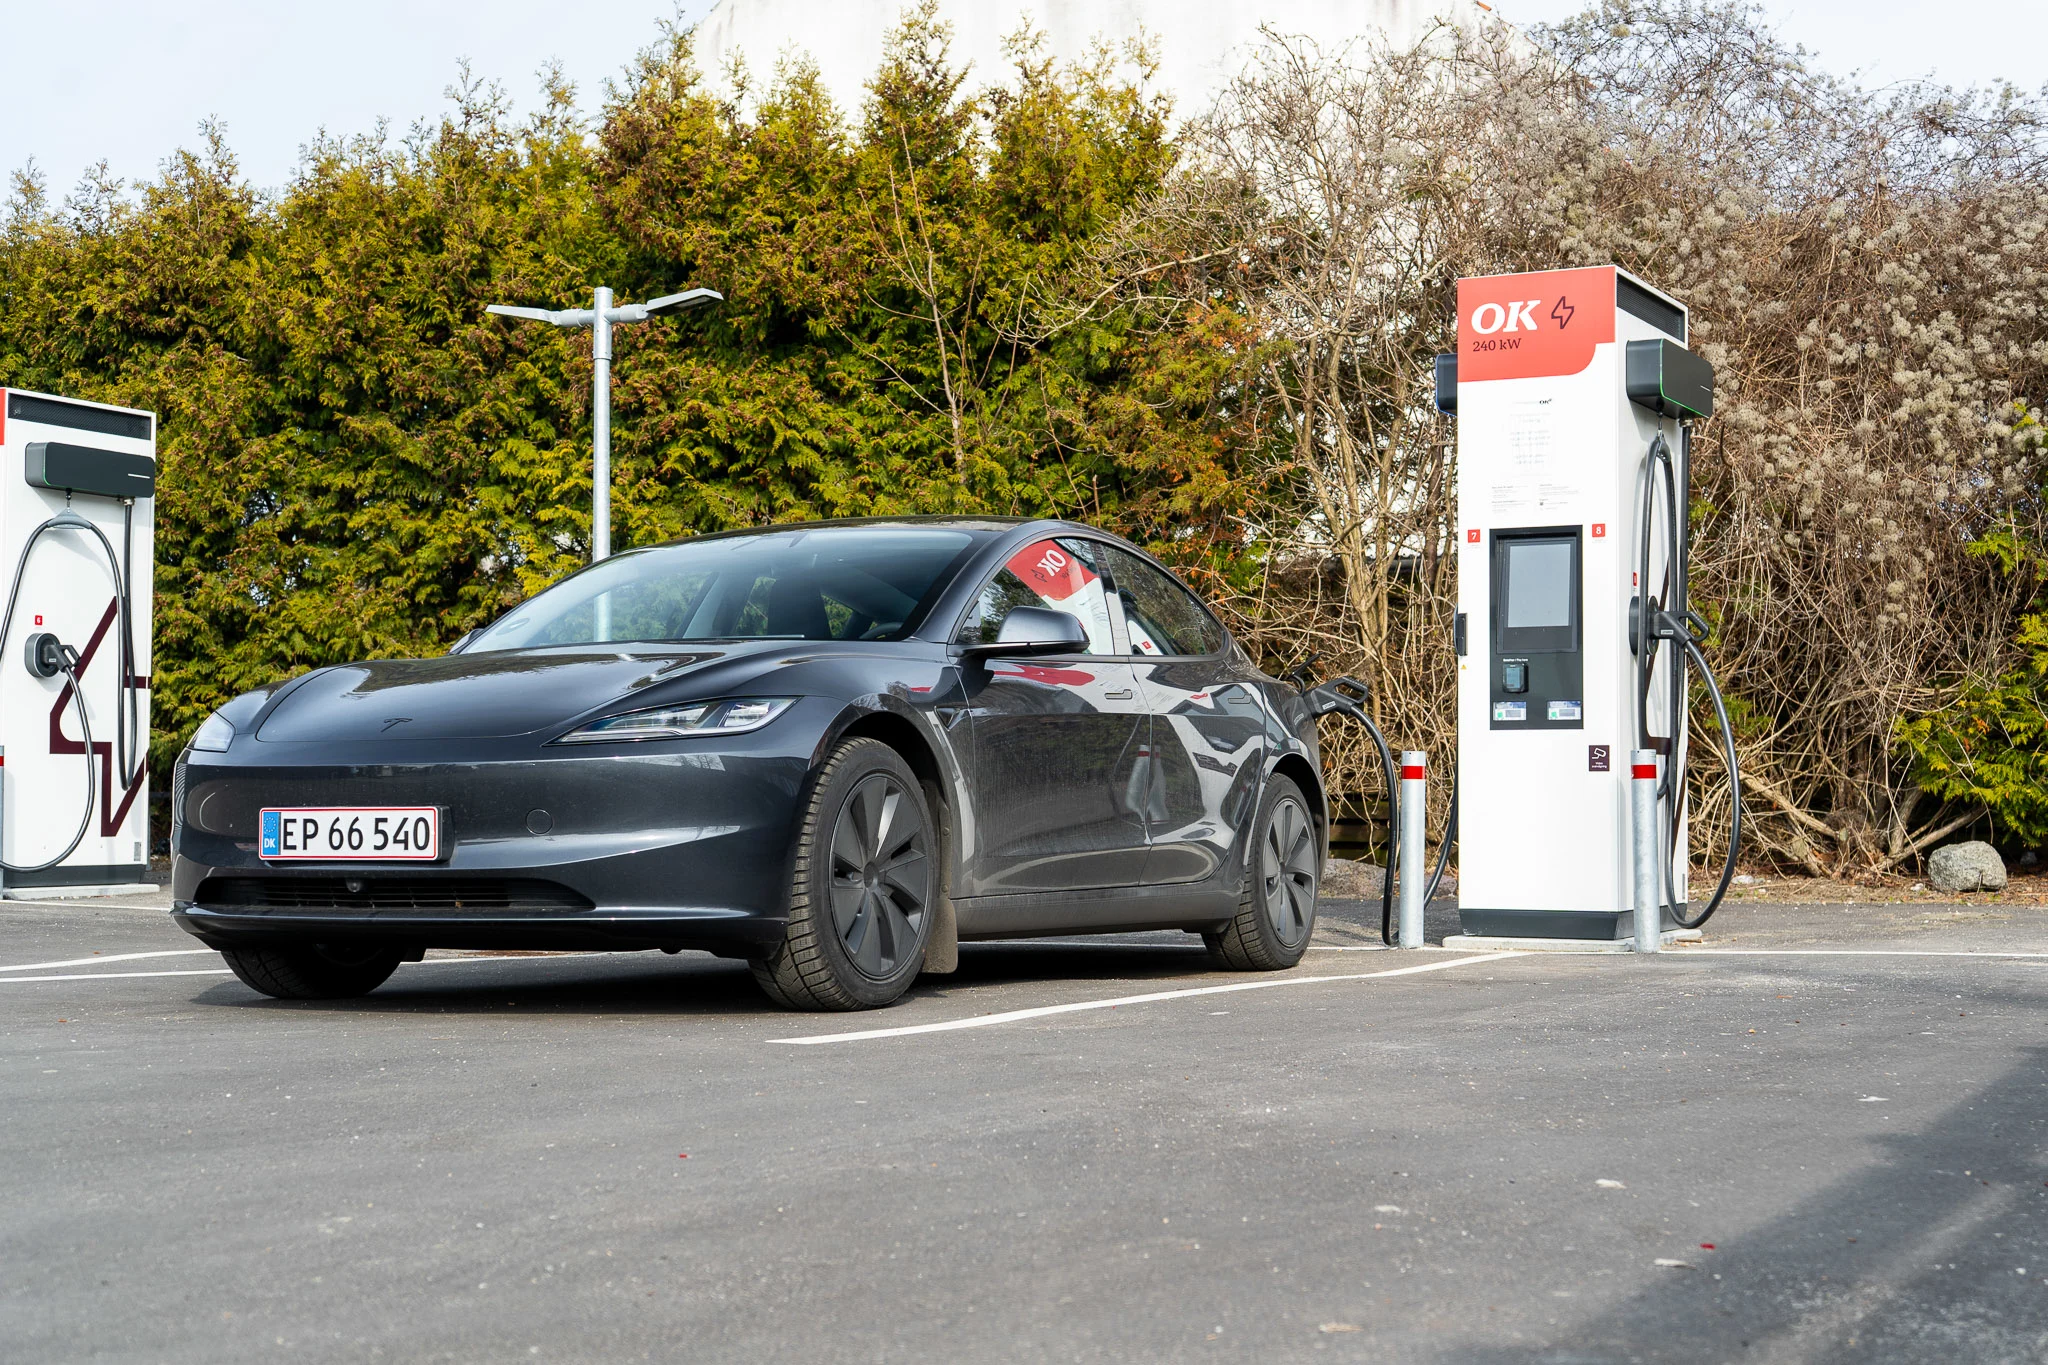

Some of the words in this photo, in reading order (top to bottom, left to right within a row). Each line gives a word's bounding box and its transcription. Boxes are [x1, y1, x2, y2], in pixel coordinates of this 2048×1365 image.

[1471, 299, 1541, 335] OK
[1472, 340, 1496, 352] 240
[1499, 338, 1522, 350] kW
[1471, 532, 1477, 540] 7
[1595, 526, 1602, 535] 8
[283, 818, 319, 851] EP
[328, 816, 364, 851] 66
[373, 816, 430, 851] 540
[264, 838, 276, 848] DK
